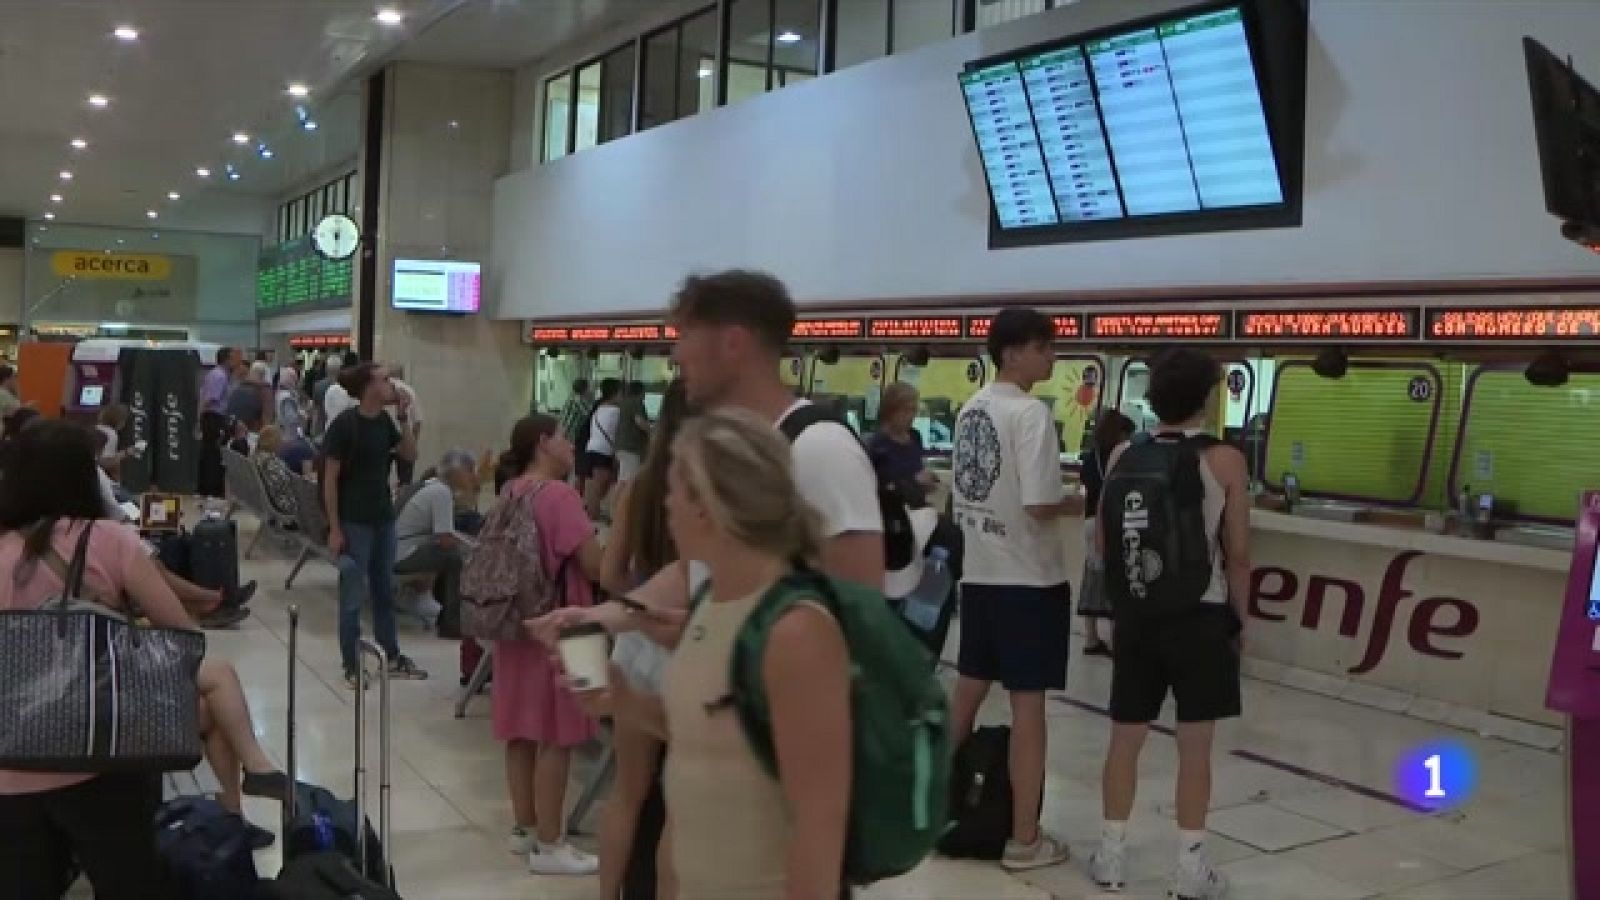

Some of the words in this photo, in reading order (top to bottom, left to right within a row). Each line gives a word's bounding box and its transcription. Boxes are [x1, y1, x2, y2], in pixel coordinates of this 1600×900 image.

[74, 257, 149, 273] acerca
[1411, 381, 1429, 398] 20
[1122, 490, 1149, 599] ellesse
[1246, 550, 1480, 675] enfe
